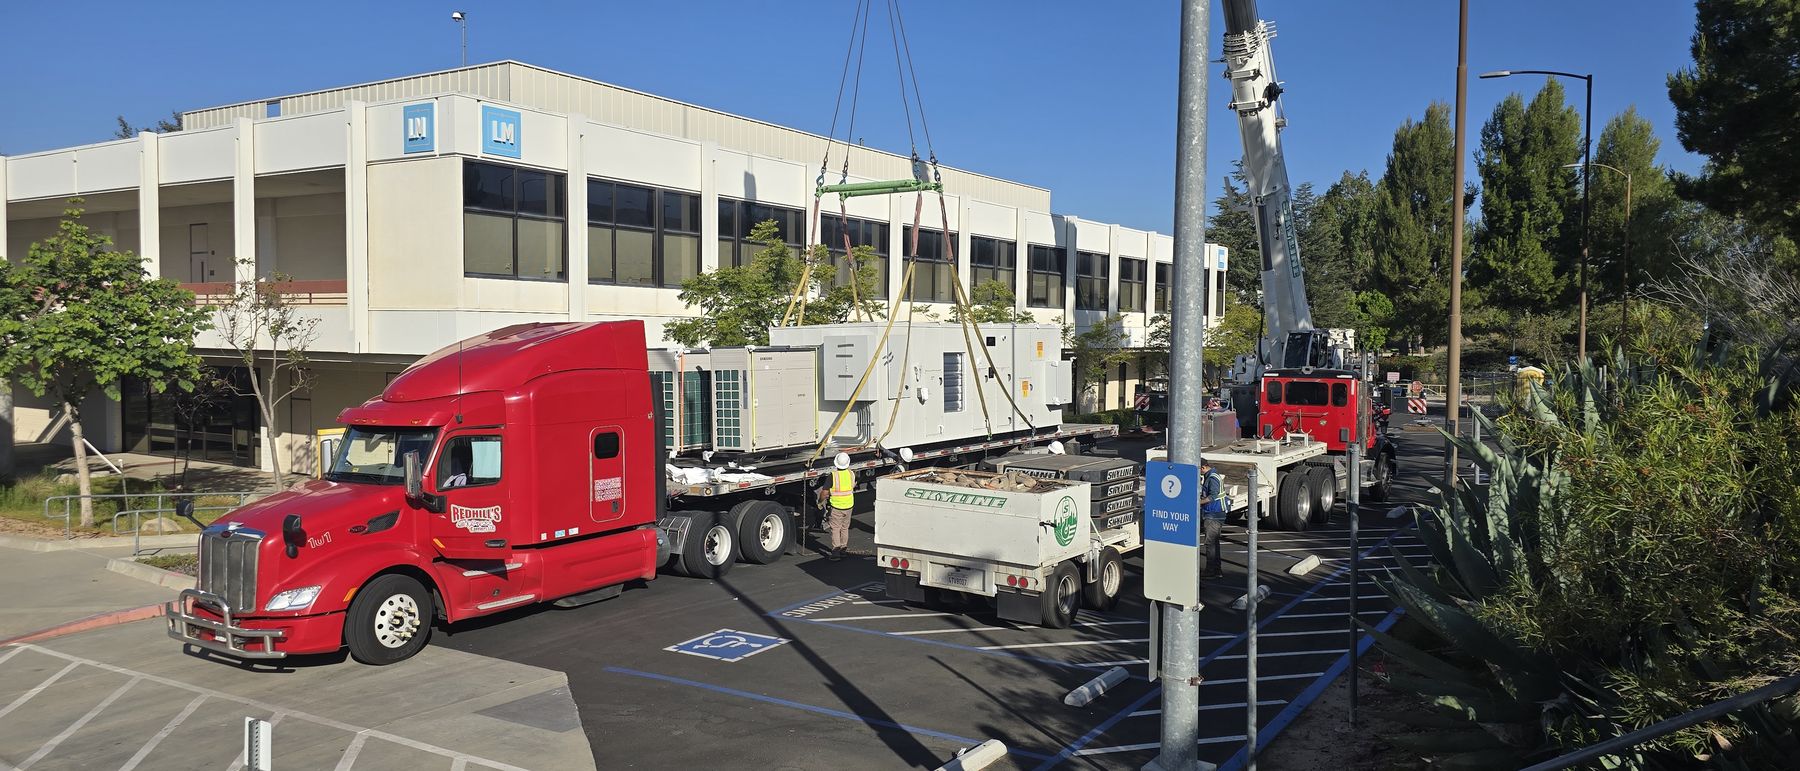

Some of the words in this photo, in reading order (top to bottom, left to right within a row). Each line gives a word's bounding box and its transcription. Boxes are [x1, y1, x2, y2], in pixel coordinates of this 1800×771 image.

[492, 120, 514, 145] LM
[904, 487, 1007, 509] SKYLINE
[452, 506, 500, 521] REDHILL'S
[1152, 509, 1168, 519] FIND
[1170, 511, 1190, 522] YOUR
[1162, 522, 1178, 532] WAY
[782, 592, 862, 618] PARKING
